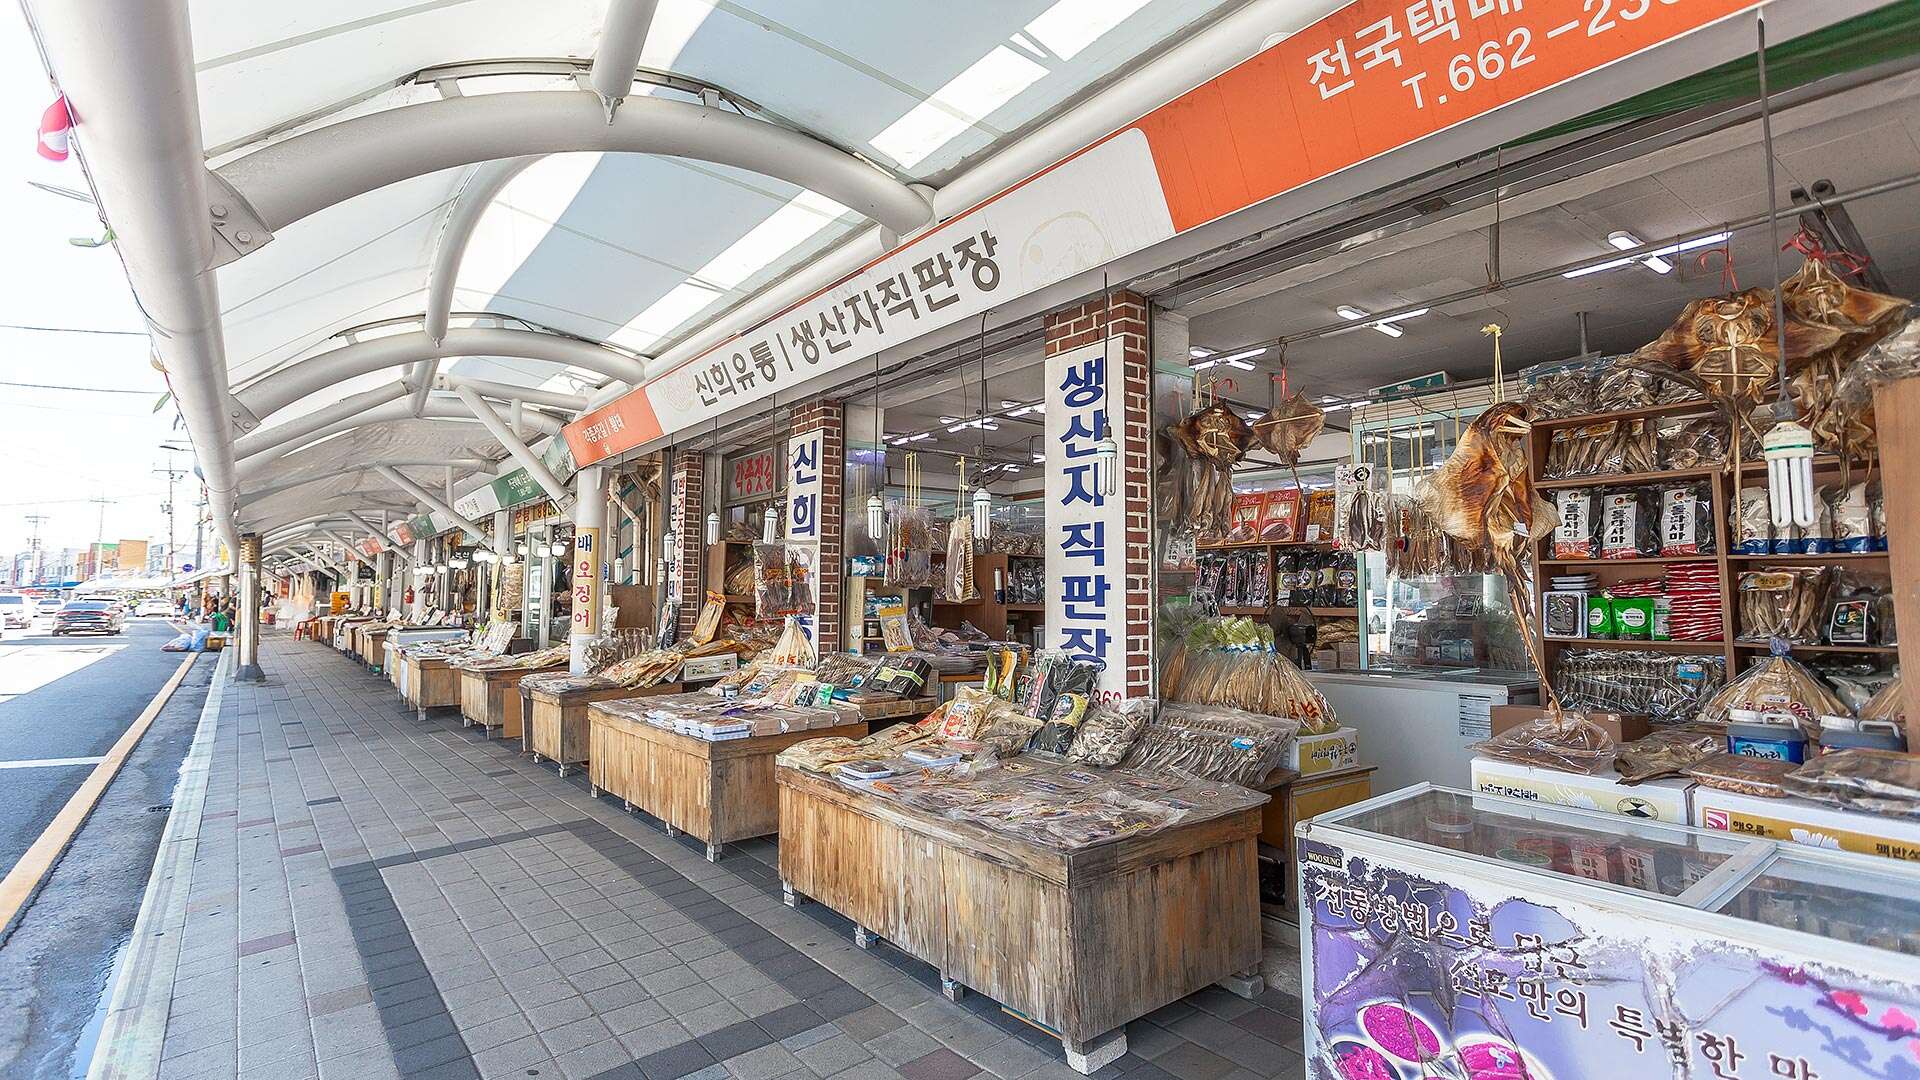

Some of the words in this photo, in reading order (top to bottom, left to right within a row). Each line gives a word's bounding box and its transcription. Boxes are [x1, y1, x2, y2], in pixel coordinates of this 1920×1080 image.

[1401, 0, 1681, 109] T.662-23
[694, 341, 776, 406] 신희유통
[791, 229, 1001, 364] 생산자직판장
[734, 452, 773, 497] 각종젓갈
[574, 533, 595, 628] 배오징어
